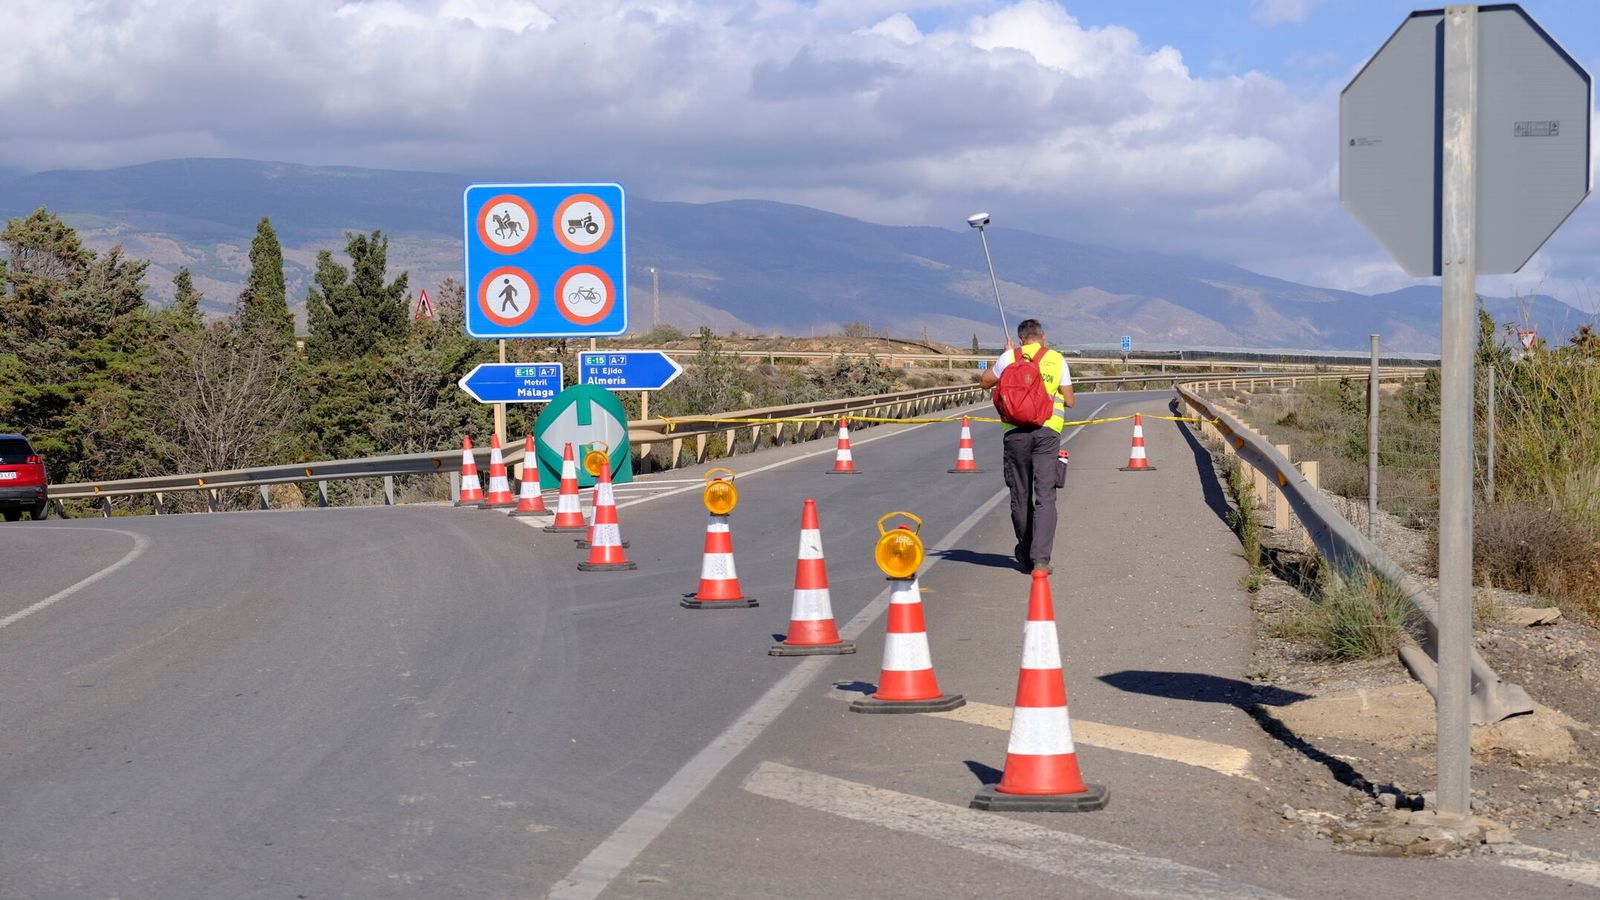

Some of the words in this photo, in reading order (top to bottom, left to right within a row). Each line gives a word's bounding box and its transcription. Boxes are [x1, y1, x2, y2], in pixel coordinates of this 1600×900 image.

[586, 356, 605, 364] E-15
[611, 356, 625, 364] A-7
[516, 368, 534, 376] E-15
[602, 367, 623, 375] Ejido
[524, 378, 548, 386] Motril
[587, 376, 626, 385] Almería
[517, 388, 554, 398] Málaga
